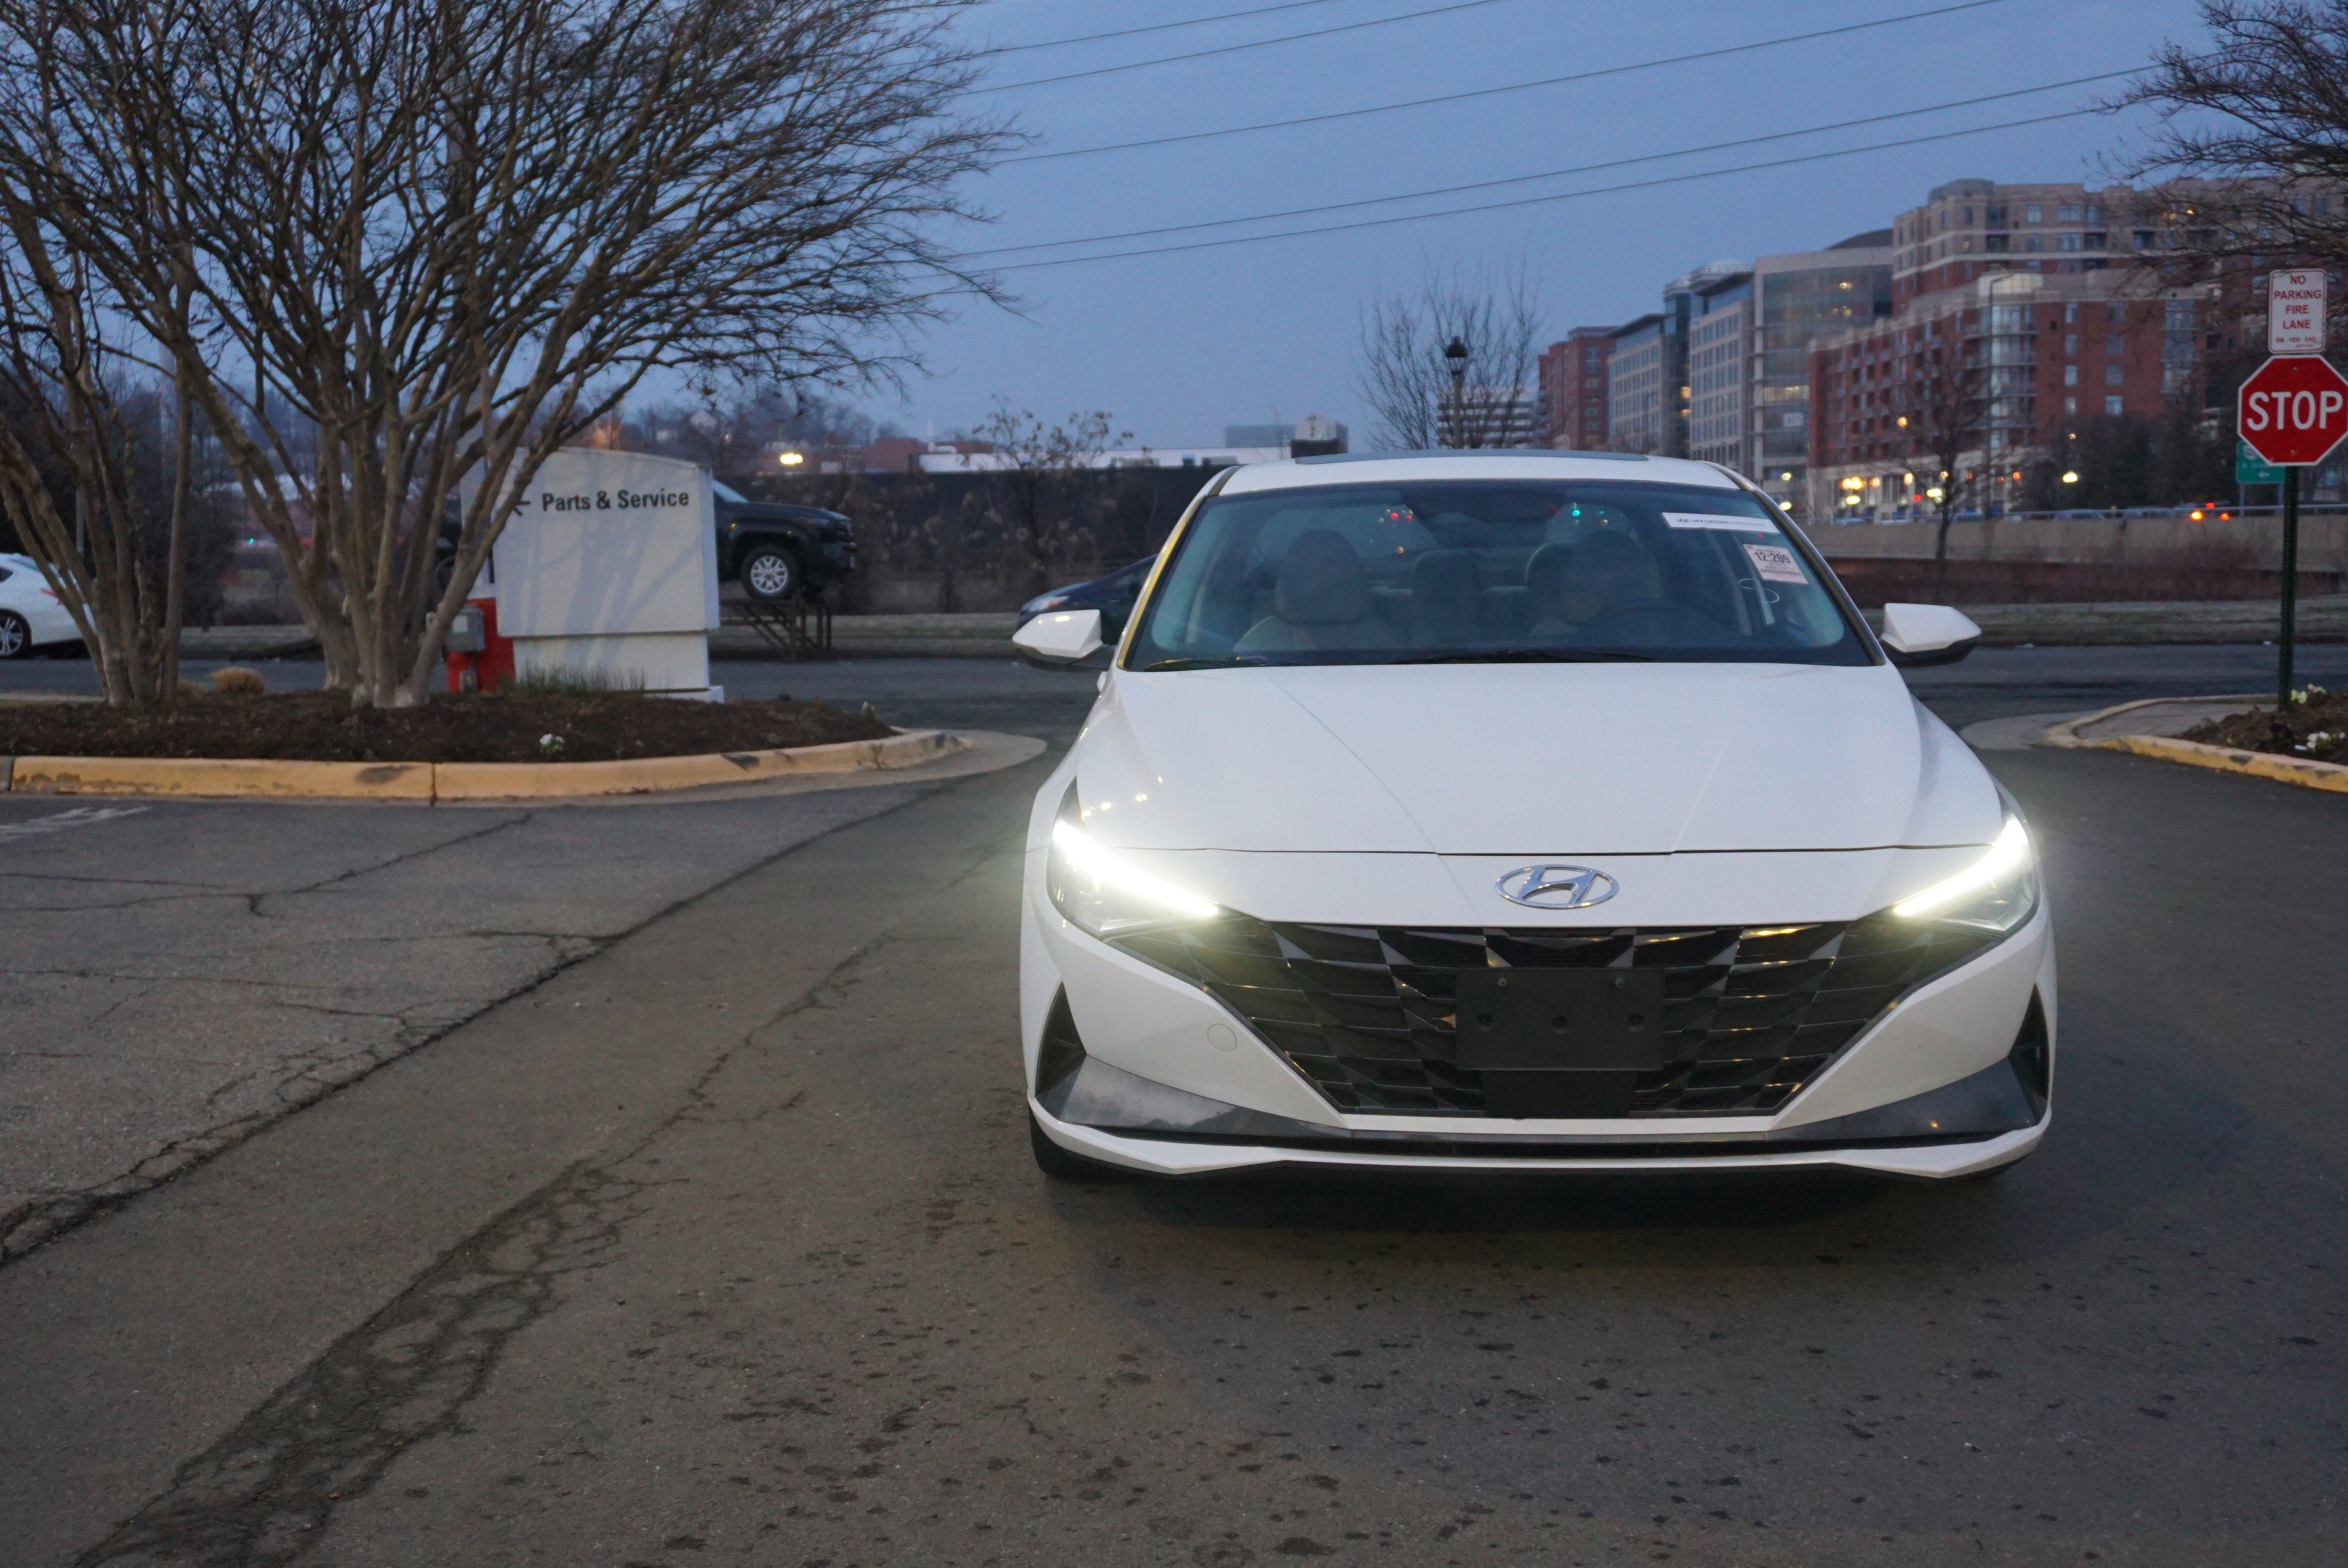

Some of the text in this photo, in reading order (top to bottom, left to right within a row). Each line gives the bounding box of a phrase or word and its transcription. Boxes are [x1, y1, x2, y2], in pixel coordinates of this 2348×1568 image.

[2290, 275, 2306, 285] NO
[2274, 290, 2321, 299] PARKING
[2285, 305, 2309, 314] FIRE
[2283, 319, 2311, 329] LANE
[2247, 390, 2343, 431] STOP
[542, 487, 689, 512] Parts & Service
